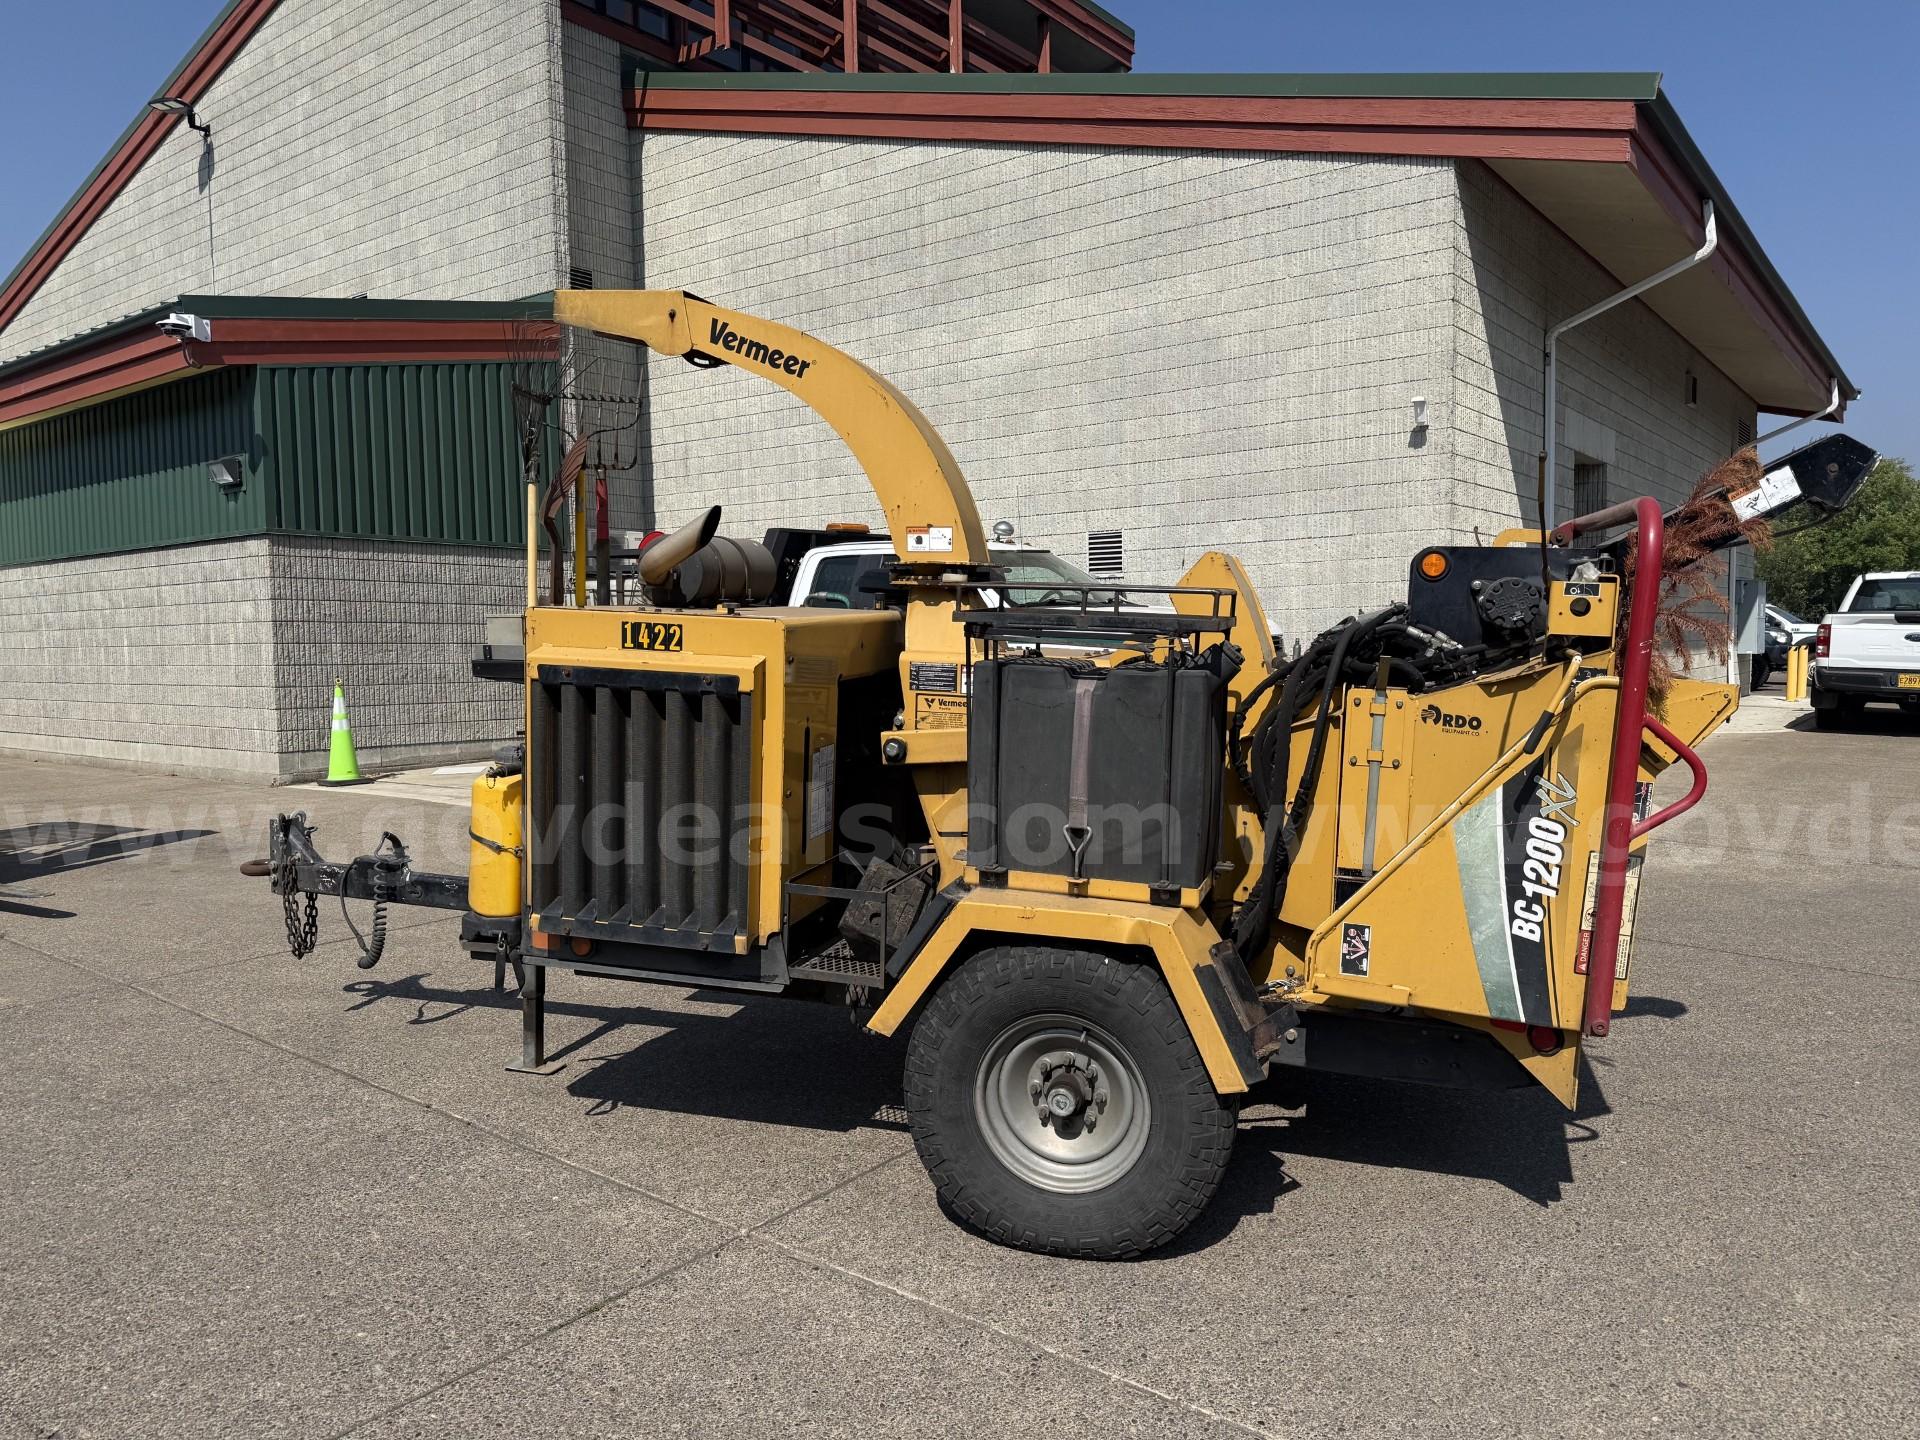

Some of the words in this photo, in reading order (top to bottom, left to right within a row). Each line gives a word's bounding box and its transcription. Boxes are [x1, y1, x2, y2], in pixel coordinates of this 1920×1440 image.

[709, 317, 811, 379] Vermeer
[624, 622, 681, 651] 1422
[938, 698, 968, 708] Vermee
[1442, 728, 1471, 736] EQUIPMENT
[1579, 932, 1590, 962] DANGER
